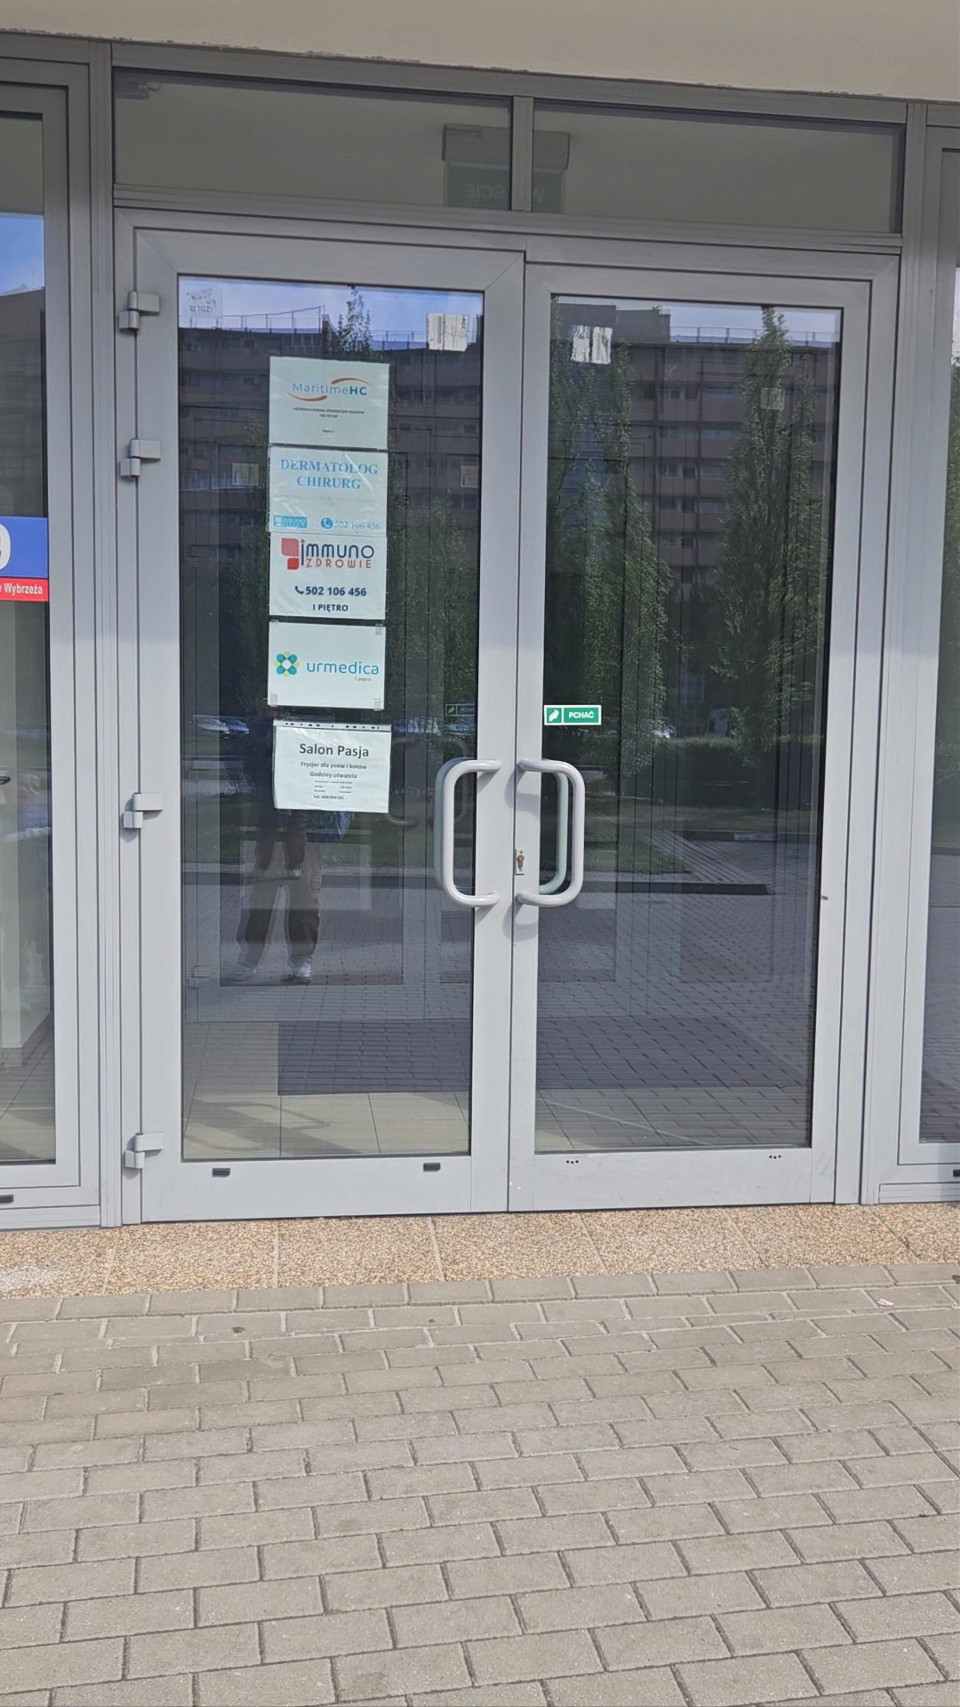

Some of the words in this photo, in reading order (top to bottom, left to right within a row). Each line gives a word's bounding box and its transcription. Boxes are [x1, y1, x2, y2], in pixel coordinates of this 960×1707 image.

[292, 382, 368, 396] MaritimeHC
[280, 459, 379, 476] DERMATOLOG
[296, 475, 361, 490] CHIRURG
[306, 558, 372, 569] ZDROWIE
[4, 582, 43, 596] Wybrzeża
[305, 586, 324, 596] 502
[328, 587, 346, 597] 106
[348, 587, 367, 597] 456
[318, 604, 349, 613] PIĘTRO
[306, 661, 379, 675] urmedica
[568, 710, 595, 719] PCHAĆ
[299, 743, 333, 755] Salon
[337, 745, 369, 759] Pasja
[309, 771, 332, 779] Godziny
